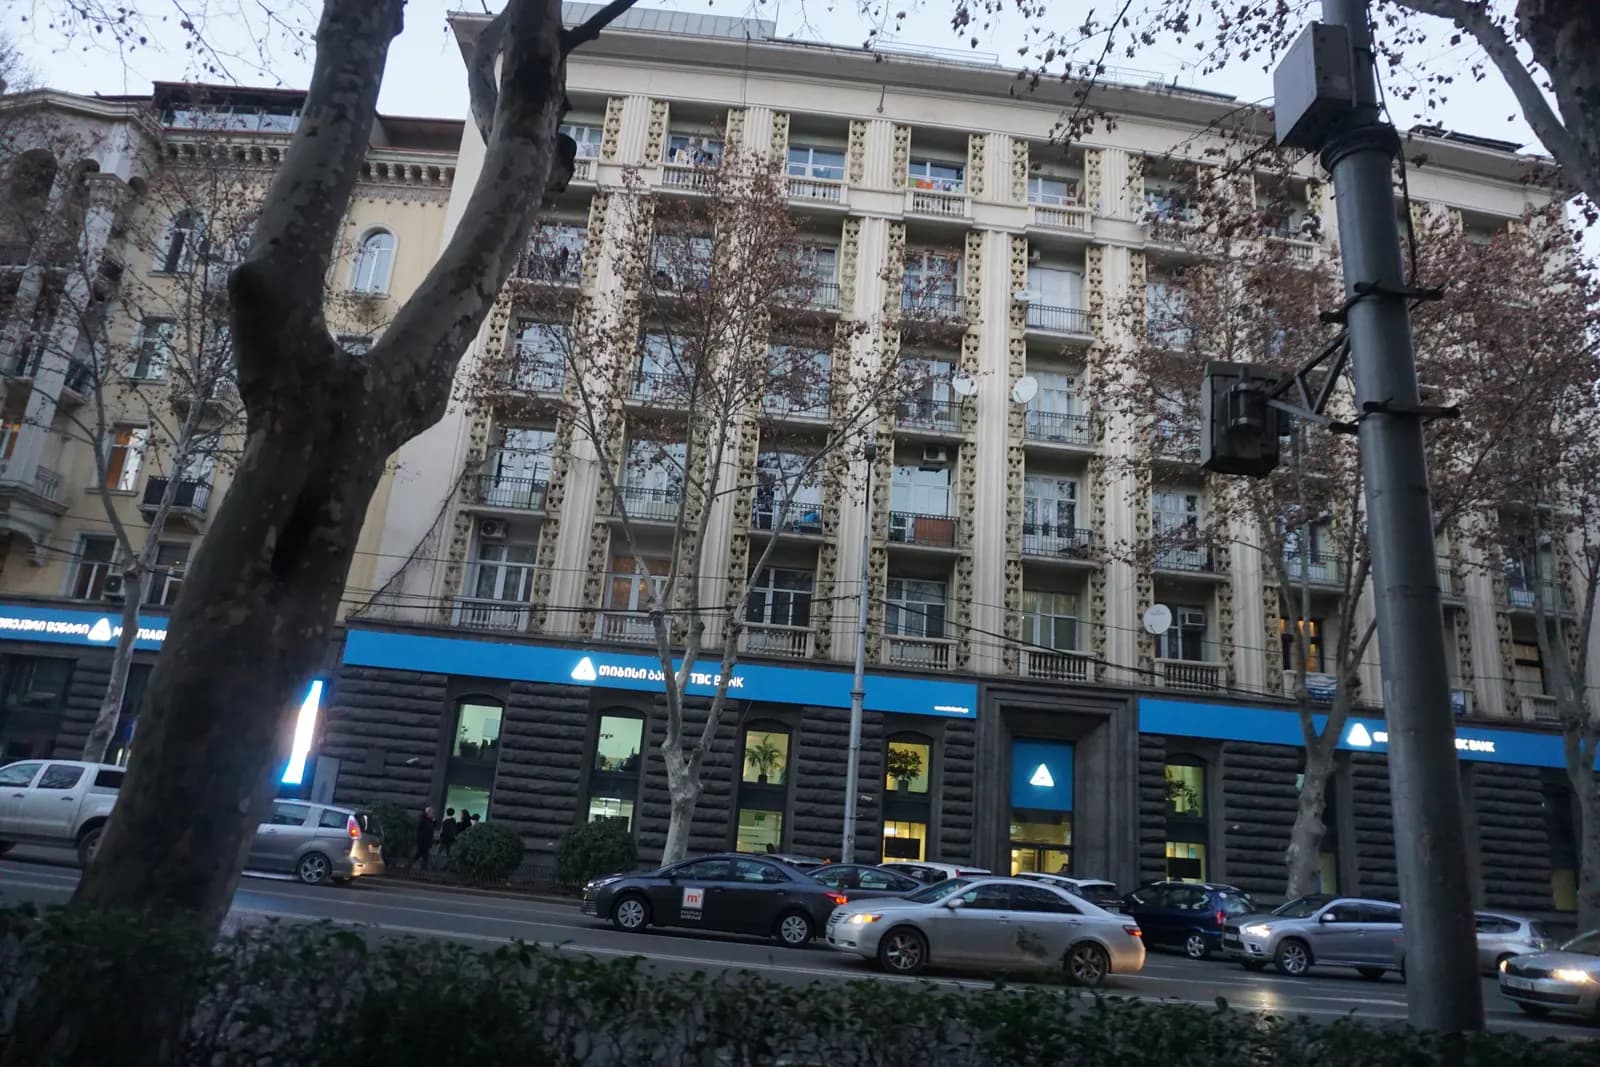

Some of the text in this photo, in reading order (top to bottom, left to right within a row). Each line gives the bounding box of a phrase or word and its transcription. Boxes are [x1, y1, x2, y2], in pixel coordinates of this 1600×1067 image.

[599, 665, 647, 679] თიბისი
[690, 672, 744, 688] TBC BNK
[1469, 739, 1495, 753] BANK
